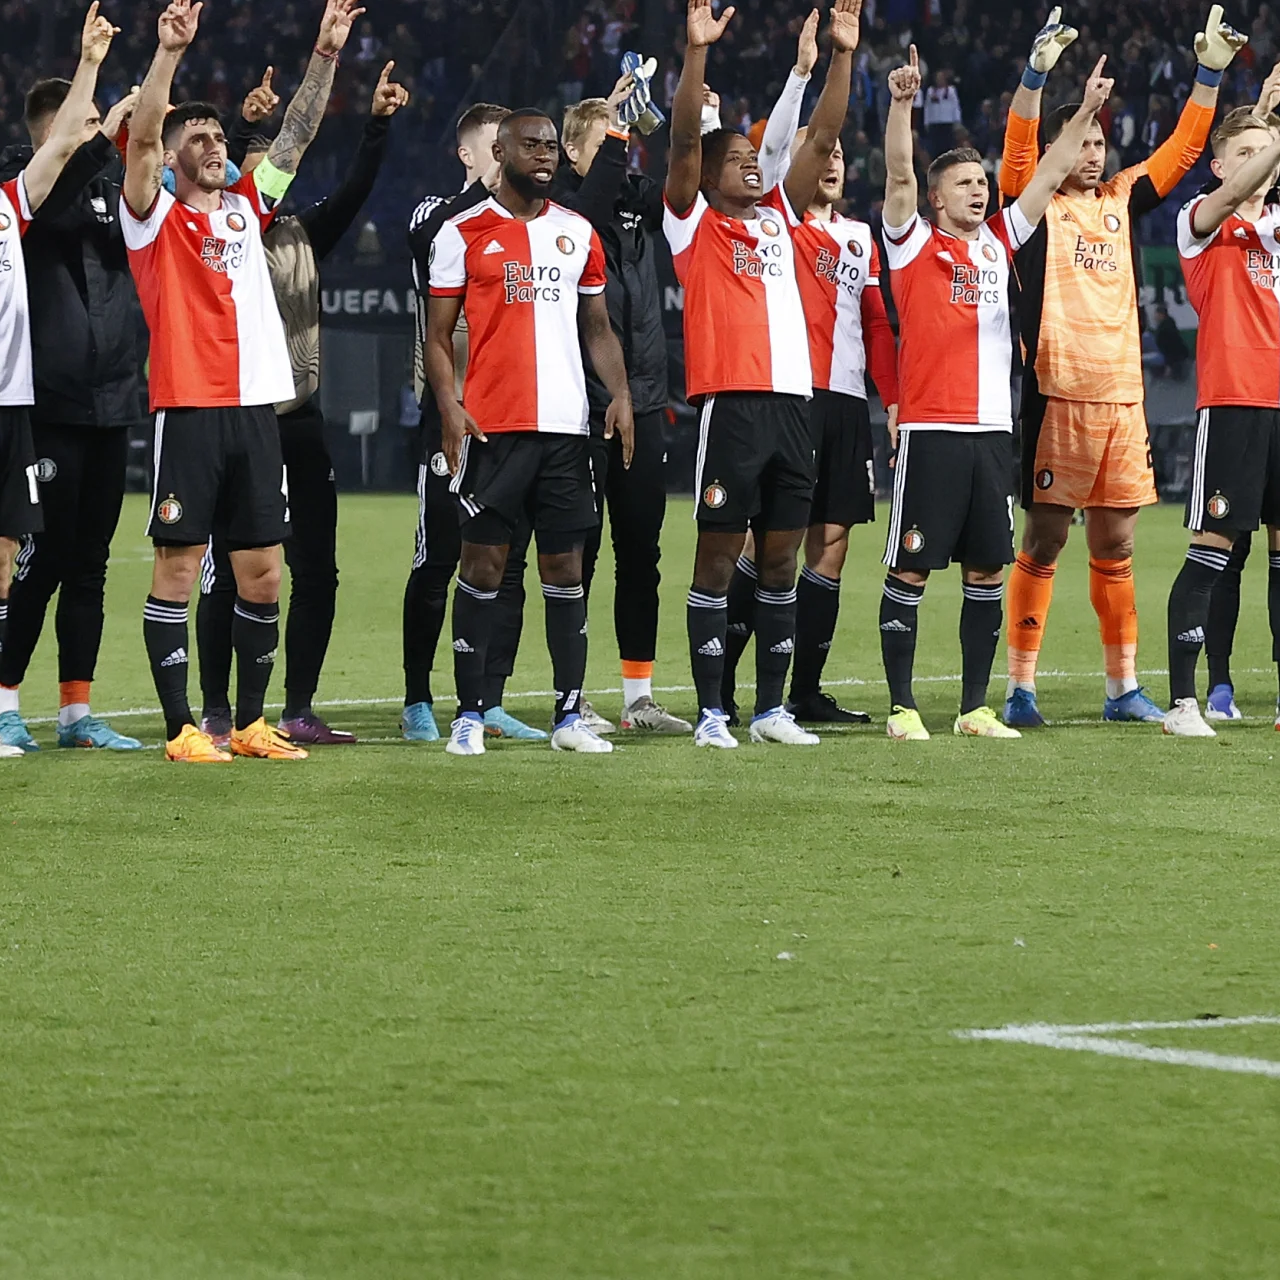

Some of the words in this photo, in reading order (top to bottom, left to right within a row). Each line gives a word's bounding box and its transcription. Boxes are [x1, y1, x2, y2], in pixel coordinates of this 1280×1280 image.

[202, 237, 242, 256] Euro
[1074, 234, 1114, 257] Euro
[734, 258, 783, 276] Parcs
[1074, 253, 1117, 272] Parcs
[504, 262, 561, 283] Euro
[952, 265, 998, 285] Euro
[321, 288, 400, 315] UEFA
[505, 284, 561, 303] Parcs
[951, 285, 999, 304] Parcs
